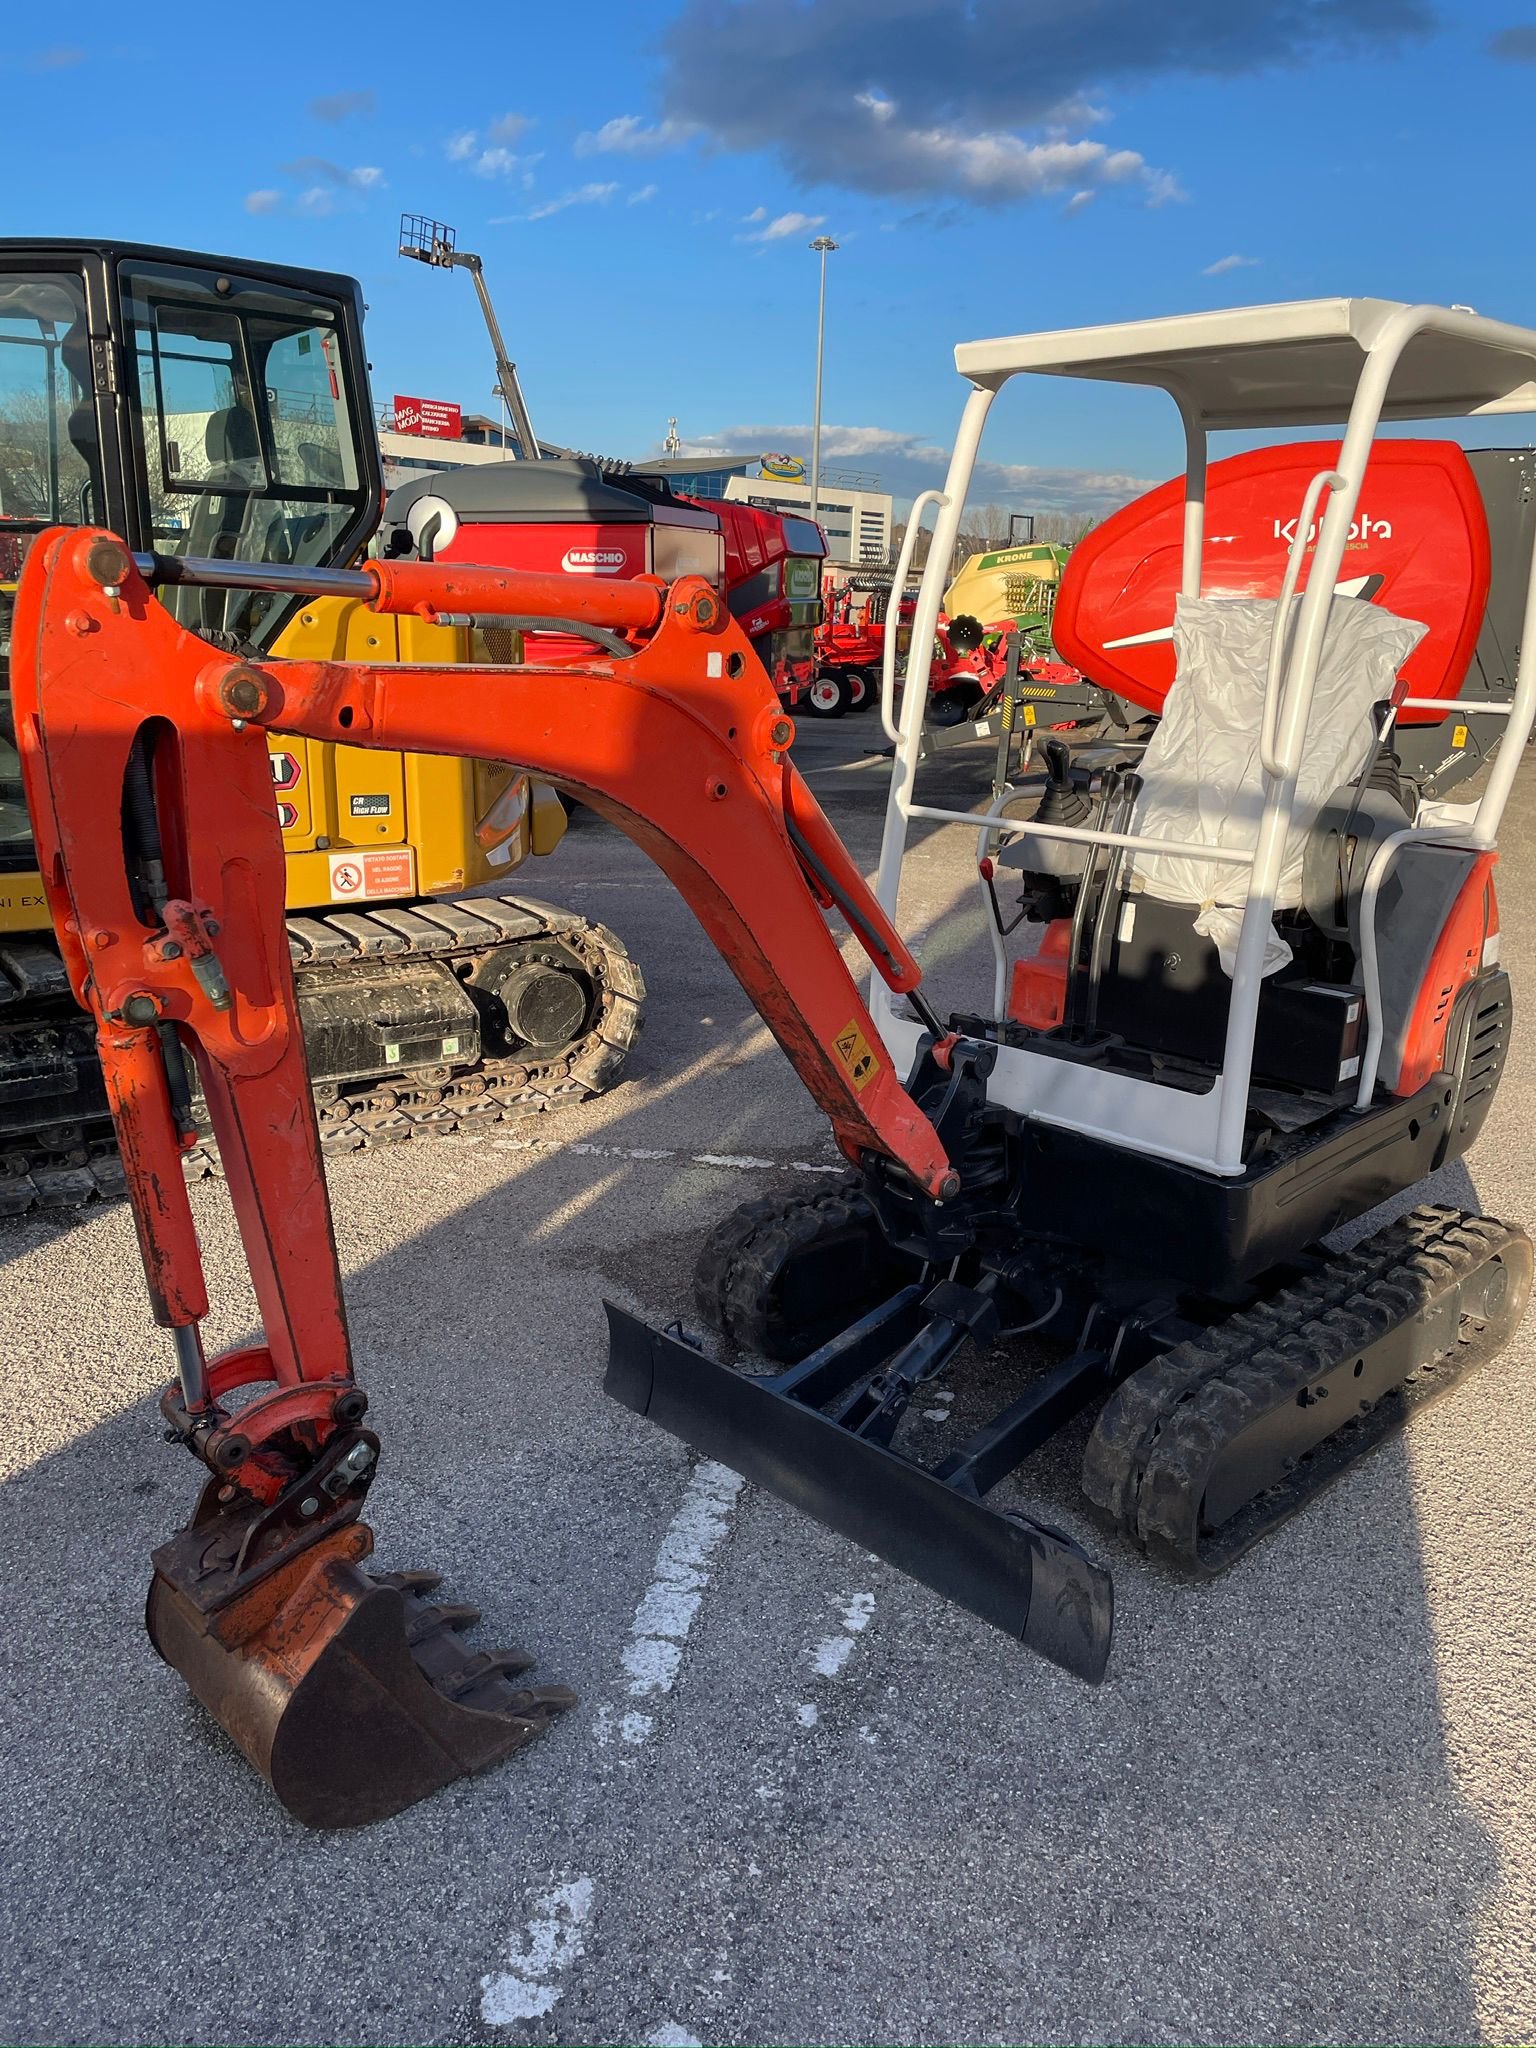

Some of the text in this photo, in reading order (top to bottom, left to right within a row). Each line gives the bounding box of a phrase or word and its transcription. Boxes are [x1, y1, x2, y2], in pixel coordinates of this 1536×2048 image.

[395, 407, 414, 422] MAG
[397, 413, 423, 430] MODA
[1274, 514, 1391, 543] Kuota
[570, 552, 624, 563] MASCHIO
[997, 552, 1033, 563] KRONE
[352, 797, 364, 805] CR
